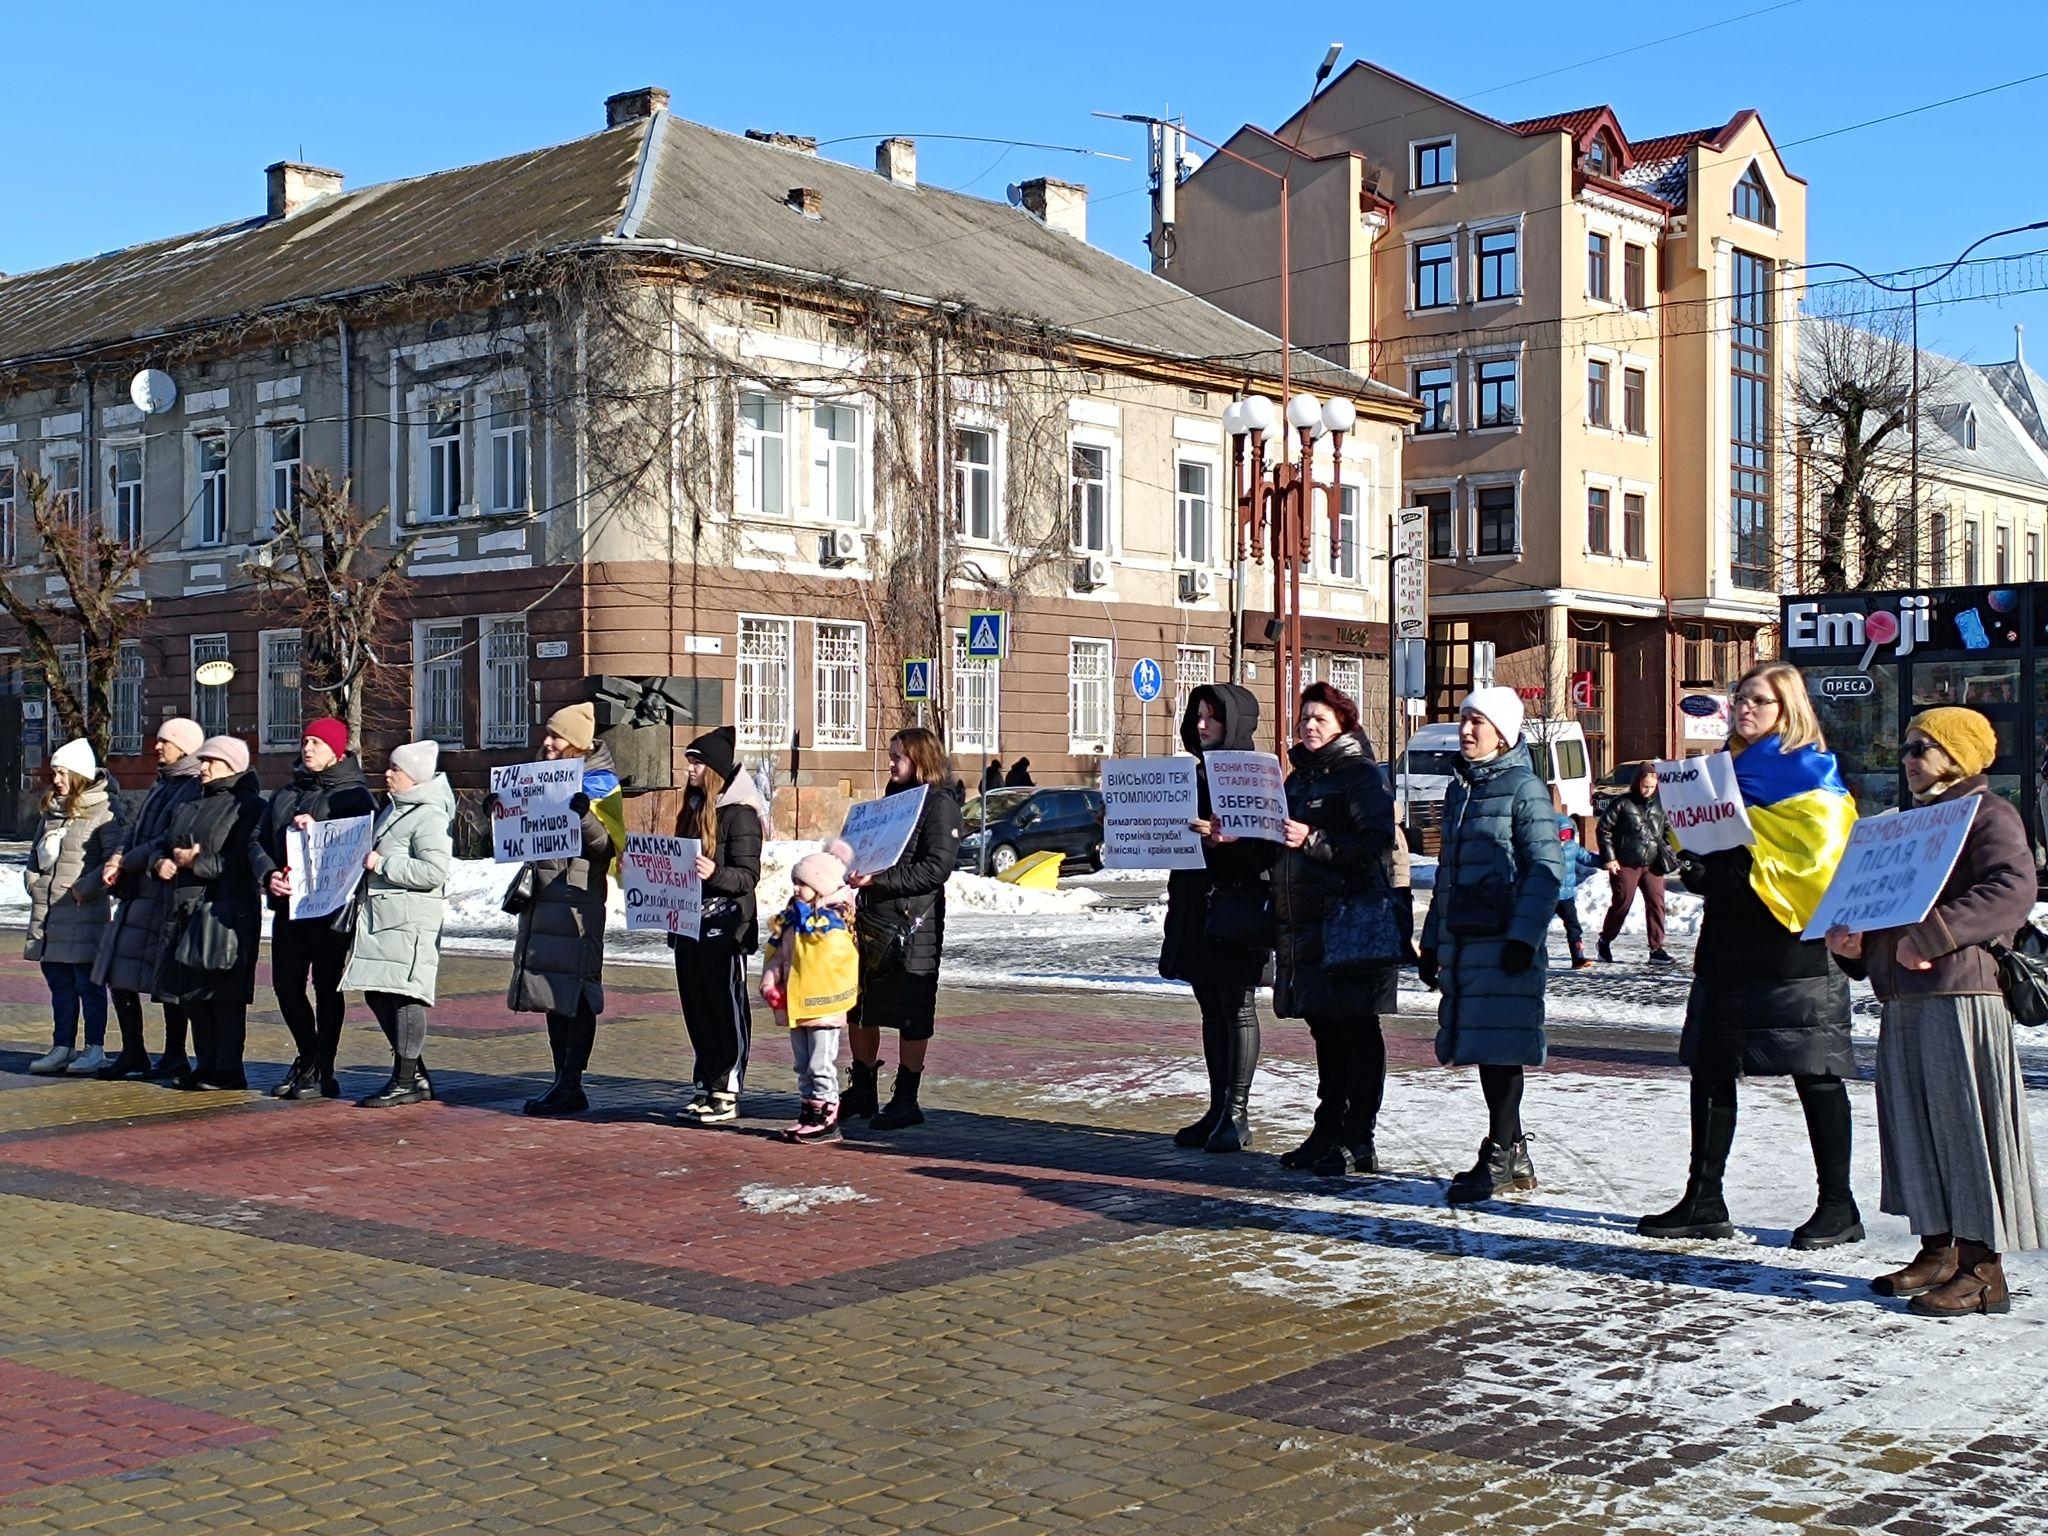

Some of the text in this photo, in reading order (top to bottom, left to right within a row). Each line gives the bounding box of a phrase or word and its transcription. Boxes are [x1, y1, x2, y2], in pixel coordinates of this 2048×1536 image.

[1826, 681, 1866, 691] ПРЕСА
[1213, 762, 1241, 773] ВОНИ
[493, 766, 520, 791] 704
[1107, 771, 1190, 786] ВІЙСЬКОВІ ТЕЖ
[1218, 776, 1250, 786] СТАЛИ
[1252, 777, 1259, 787] В
[1105, 790, 1191, 804] ВТОМЛЮЮТЬСЯ!
[1850, 802, 1971, 846] ДЕМОБІЛІЗАЦІЯ
[503, 838, 524, 857] ЧАС
[1856, 830, 1948, 874] ПІСЛЯ 18
[629, 853, 672, 870] ТЕРМІНІВ
[1845, 867, 1918, 900] МІСЯЦІВ
[666, 910, 679, 932] 18
